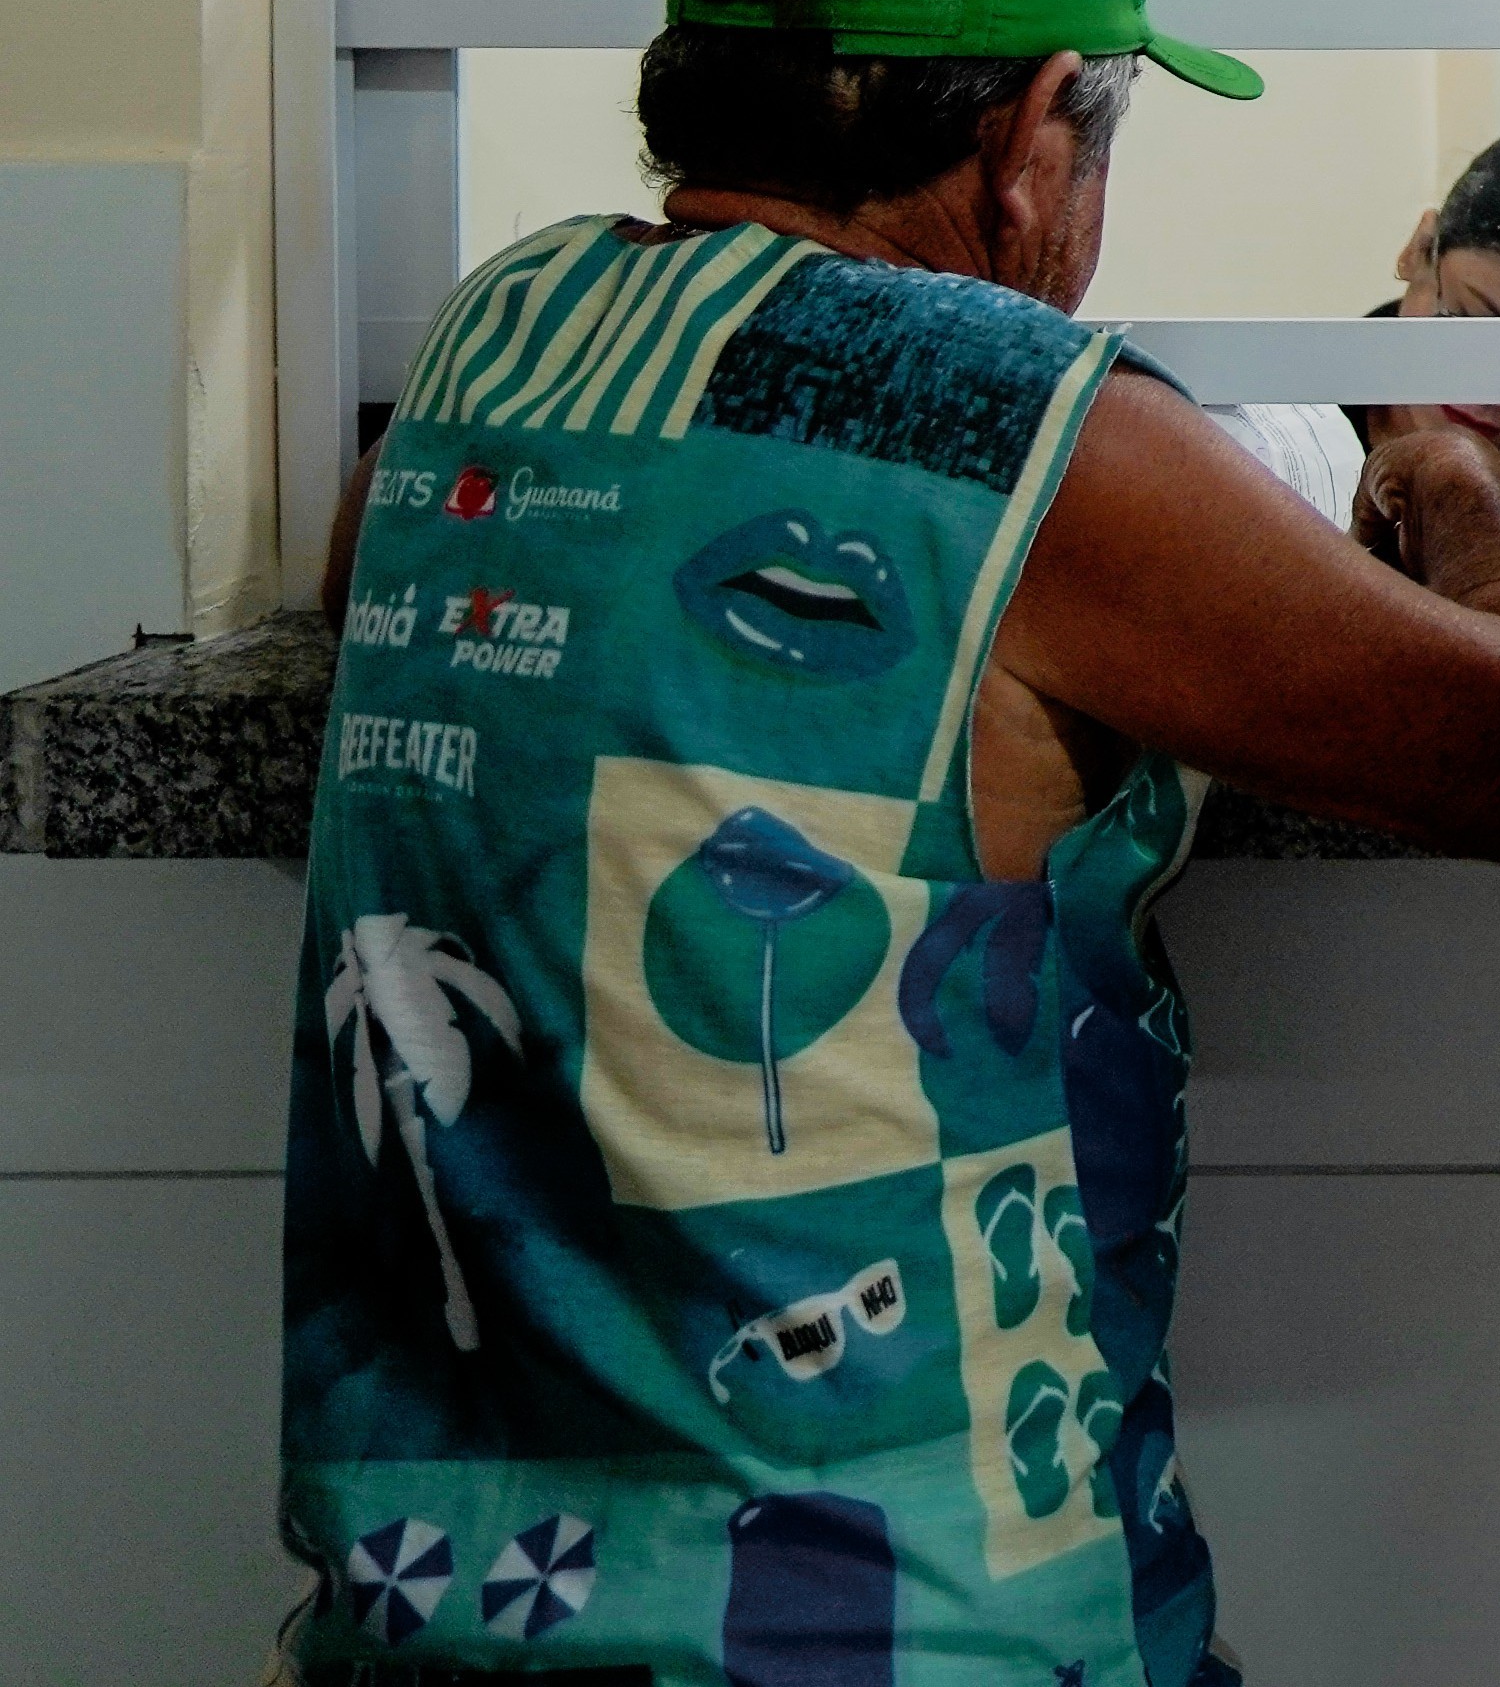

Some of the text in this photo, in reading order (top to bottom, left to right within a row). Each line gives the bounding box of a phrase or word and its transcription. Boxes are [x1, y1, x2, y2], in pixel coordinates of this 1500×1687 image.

[504, 465, 622, 521] Guaraná
[438, 585, 571, 647] EXTRA
[450, 638, 562, 679] POWER
[338, 712, 477, 797] BEEFEATER
